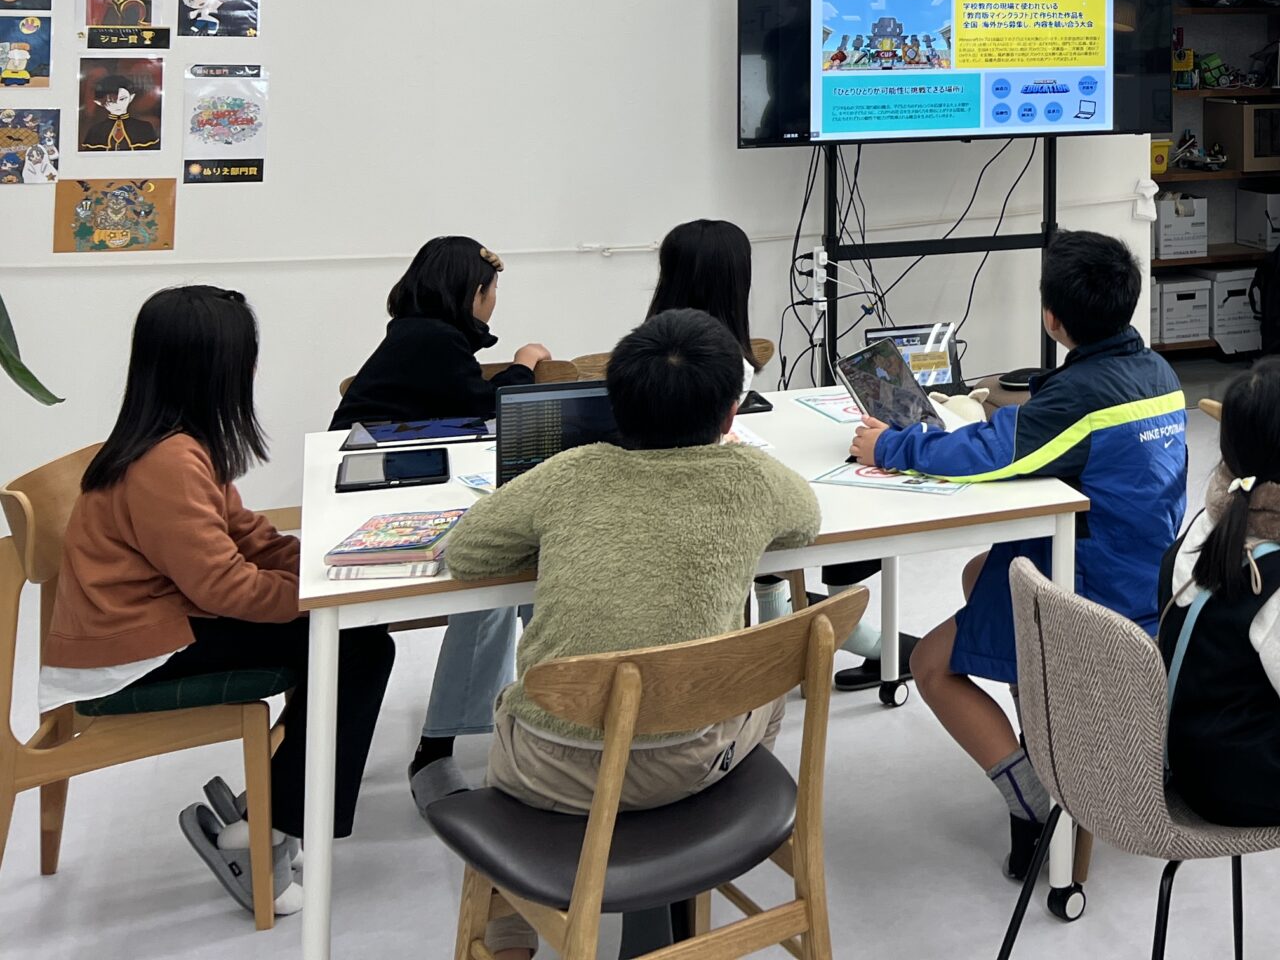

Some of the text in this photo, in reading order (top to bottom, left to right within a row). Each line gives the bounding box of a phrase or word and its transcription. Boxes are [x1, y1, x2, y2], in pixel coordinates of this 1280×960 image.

[963, 2, 1059, 10] 学校教育の現場で使われている
[202, 167, 258, 176] ぬりえ部門賞
[1139, 428, 1160, 443] NIKE
